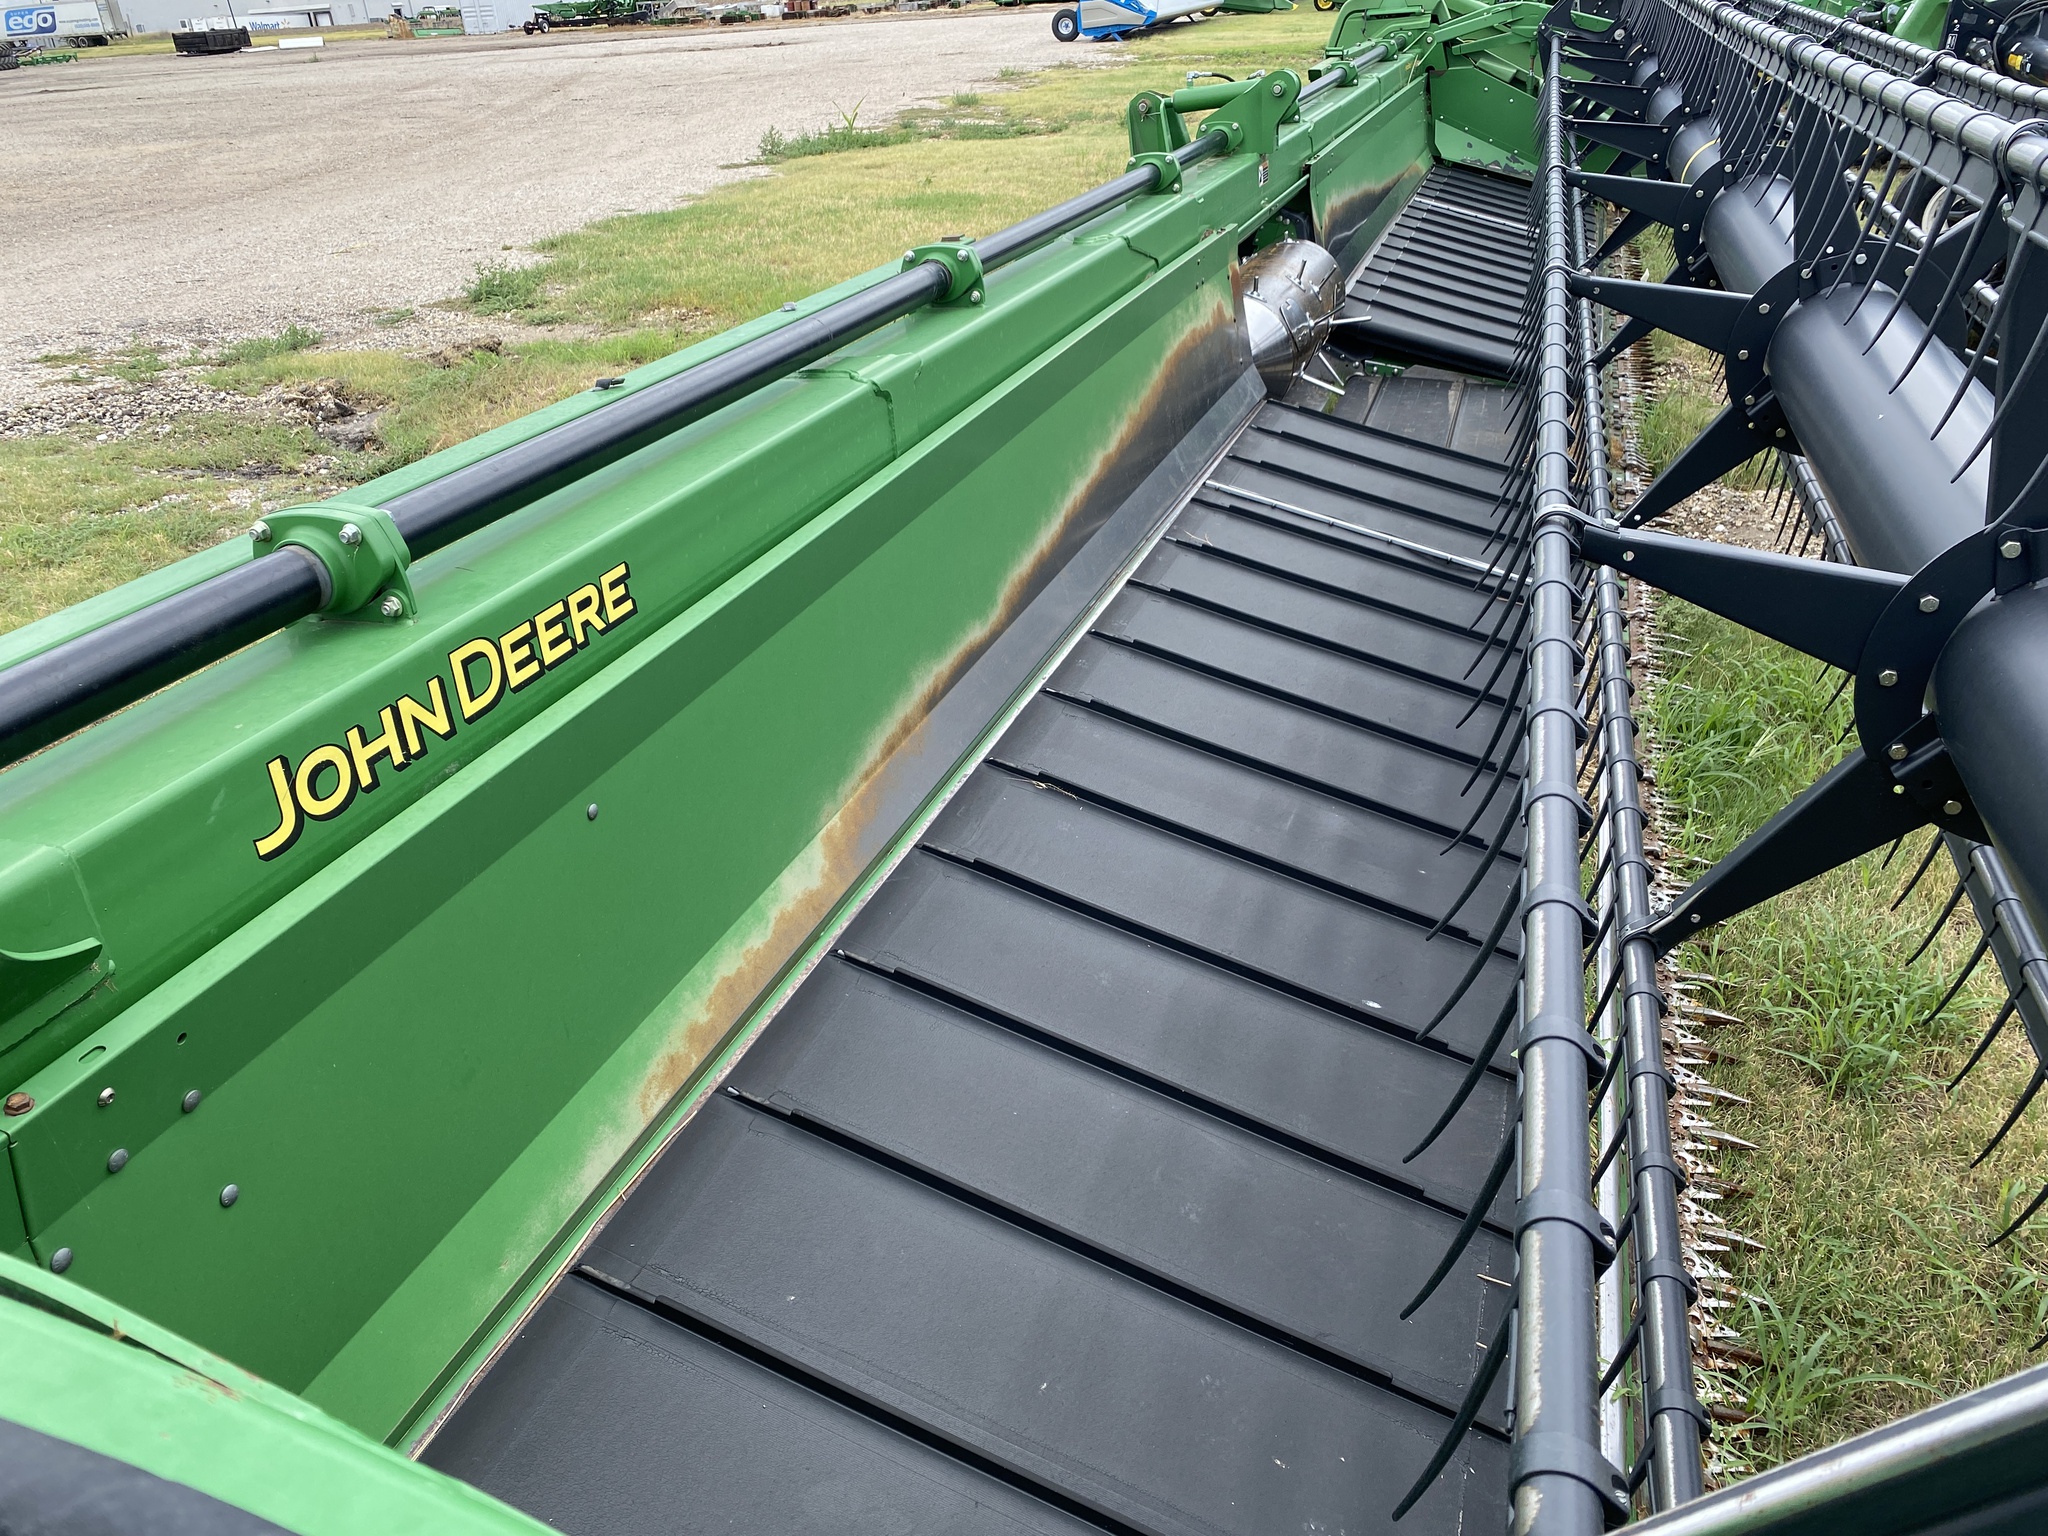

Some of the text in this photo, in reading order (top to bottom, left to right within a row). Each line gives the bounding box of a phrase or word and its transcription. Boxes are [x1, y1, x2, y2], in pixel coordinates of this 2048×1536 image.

[7, 12, 53, 31] ego
[249, 21, 280, 31] Walmart
[253, 561, 638, 861] JOHN DEERE
